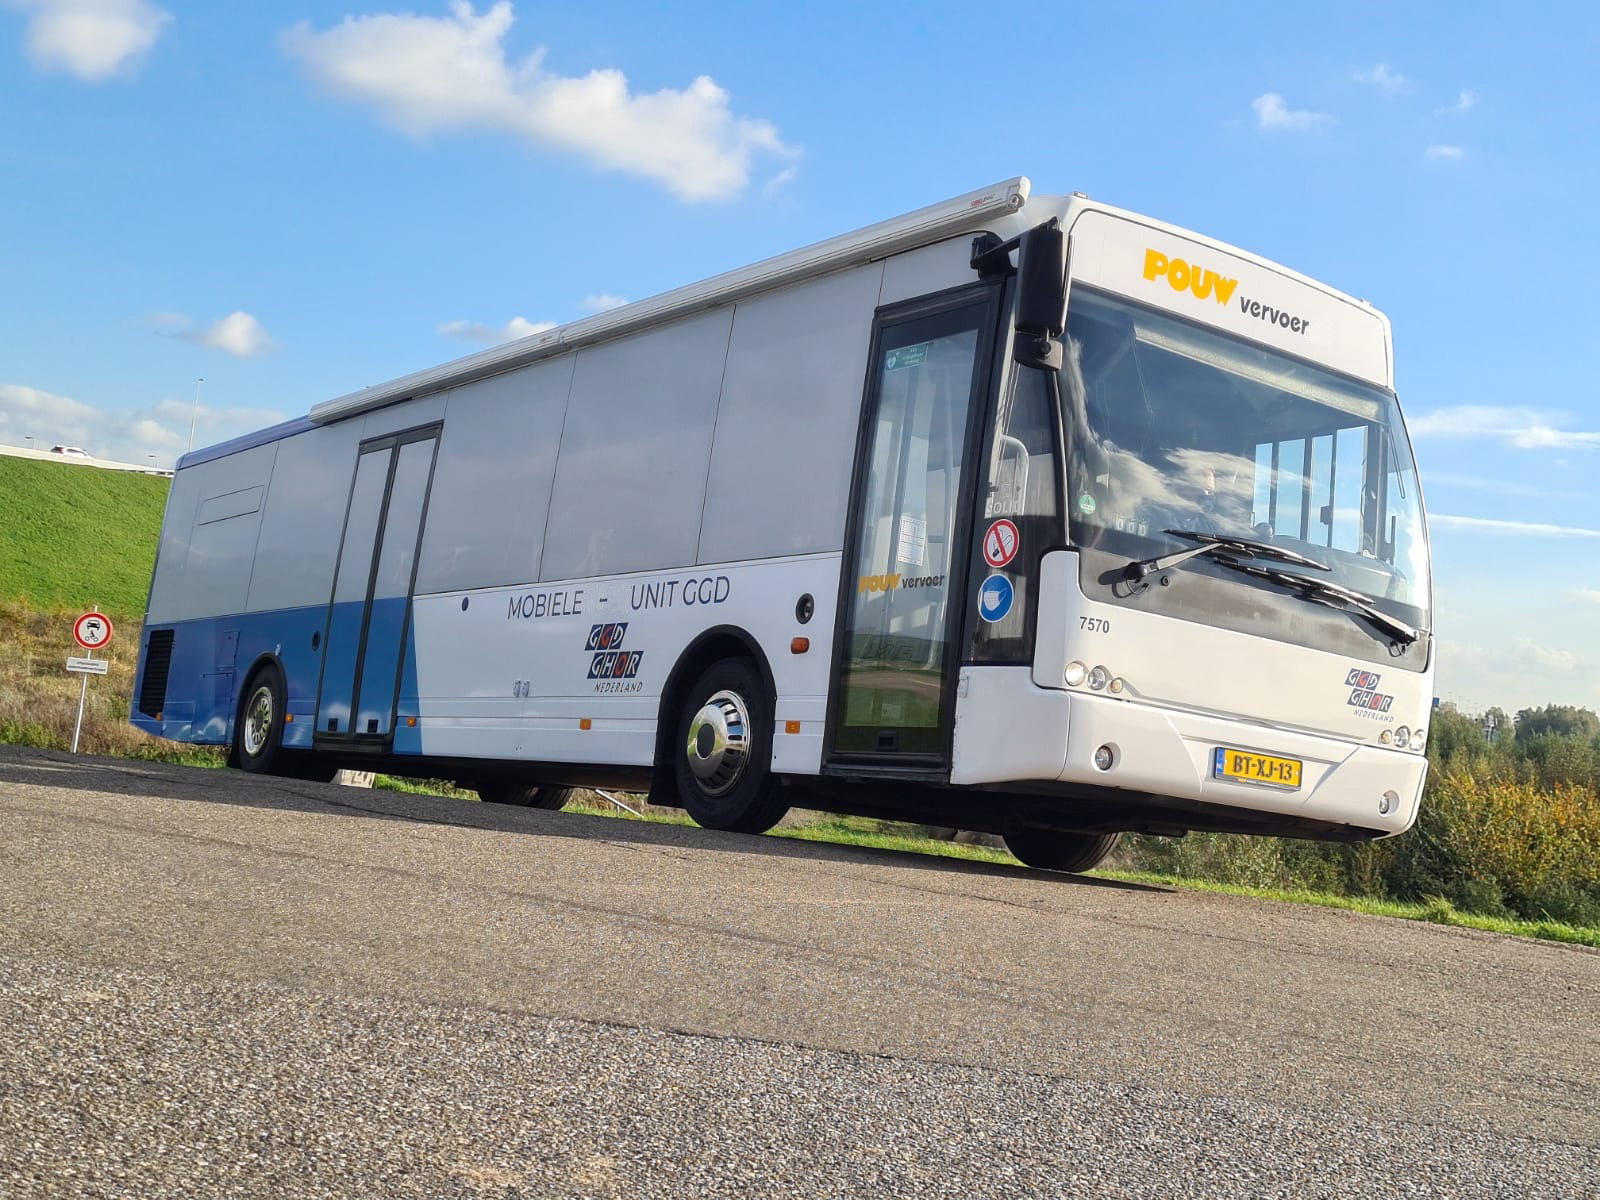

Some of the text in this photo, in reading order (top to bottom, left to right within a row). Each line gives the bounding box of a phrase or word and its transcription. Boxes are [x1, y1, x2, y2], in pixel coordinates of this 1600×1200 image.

[1143, 248, 1310, 335] POUW vervoer
[858, 572, 945, 592] POUW vervoer
[508, 590, 584, 620] MOBIELE
[631, 581, 679, 610] UNIT
[683, 576, 730, 605] GGD
[588, 624, 626, 649] GGD
[1079, 616, 1110, 634] 7570
[590, 652, 642, 677] GHOR
[594, 681, 643, 694] NEDERLAND
[1347, 669, 1380, 689] GGD
[1349, 689, 1393, 712] GHOR
[1354, 709, 1394, 723] NEDERLAND
[1233, 755, 1293, 781] BT-XJ-13
